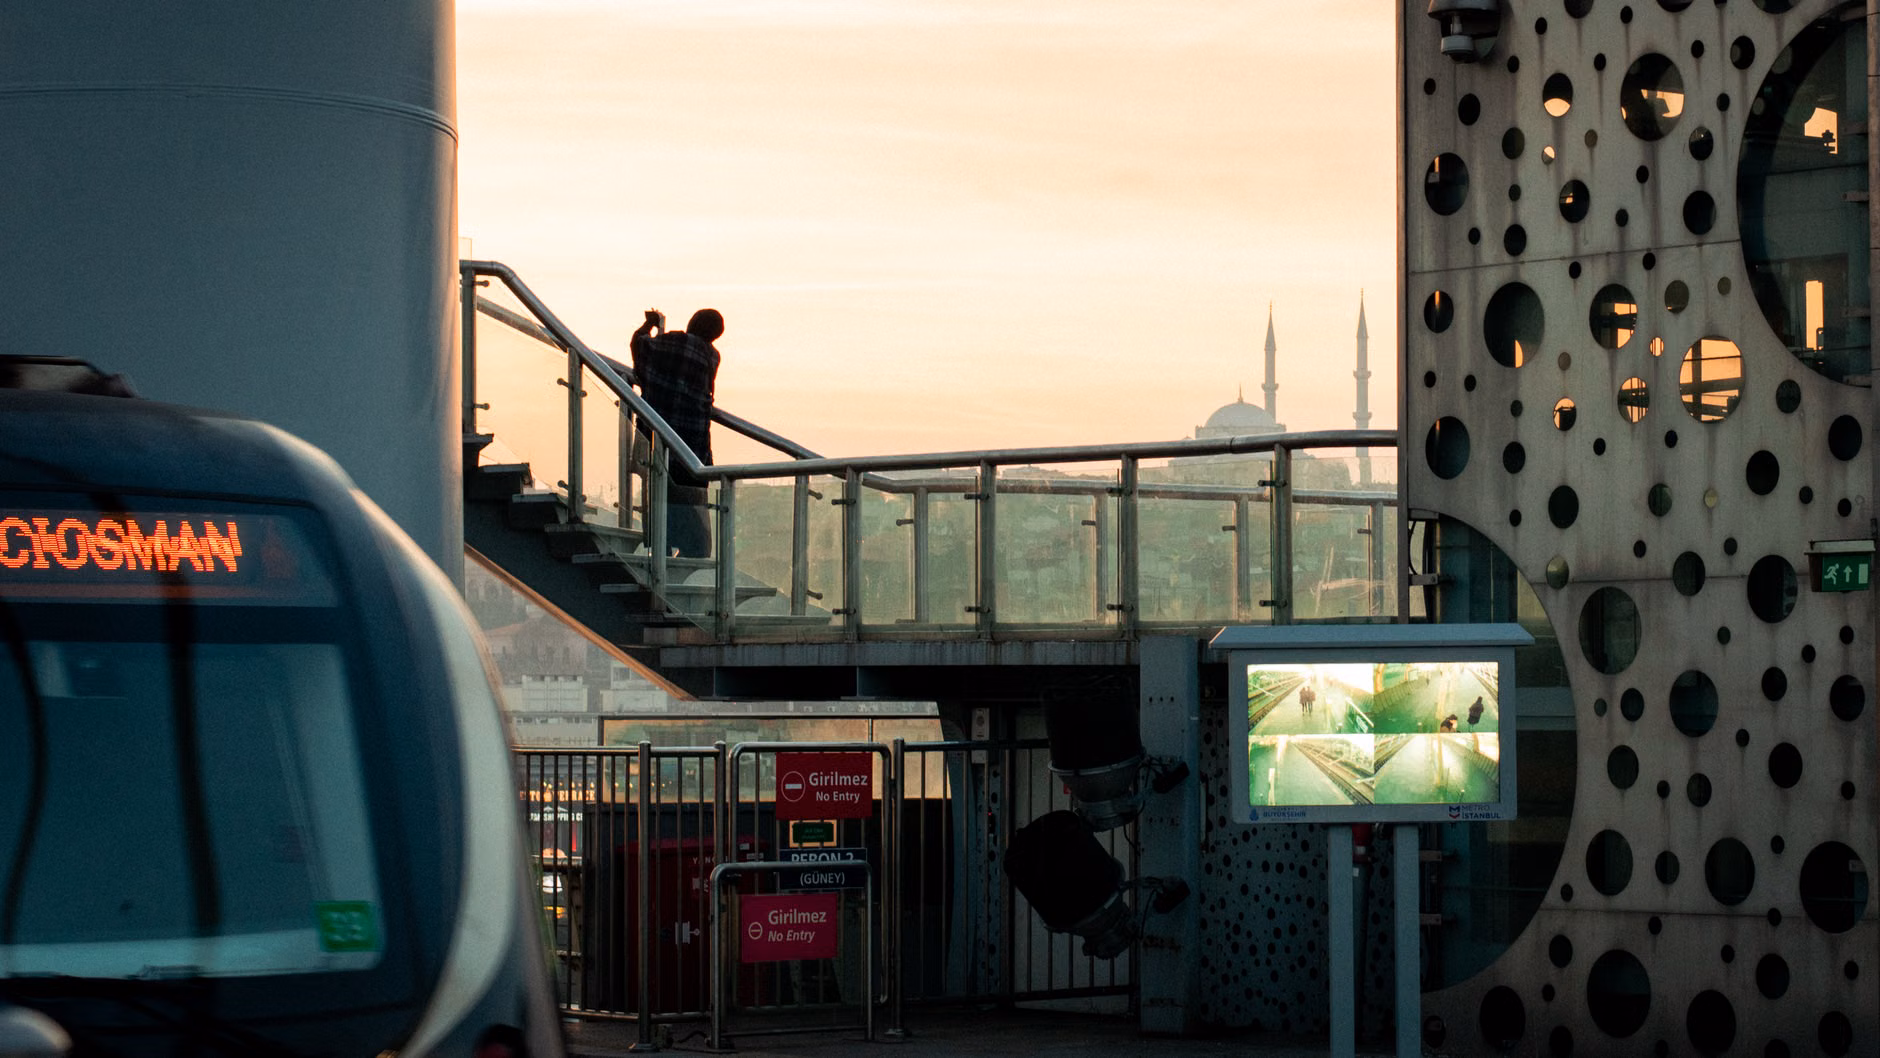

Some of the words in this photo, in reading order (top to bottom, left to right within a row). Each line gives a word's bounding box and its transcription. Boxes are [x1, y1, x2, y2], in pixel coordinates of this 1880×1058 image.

[0, 517, 242, 572] CIOSMAN
[808, 772, 868, 786] Girilmez
[816, 791, 830, 801] No
[833, 790, 860, 803] Entry
[1462, 810, 1500, 819] İSTANBUL
[800, 870, 846, 886] (GÜNEY)
[768, 909, 827, 924] Girilmez
[768, 930, 783, 942] No
[786, 930, 815, 943] Entry
